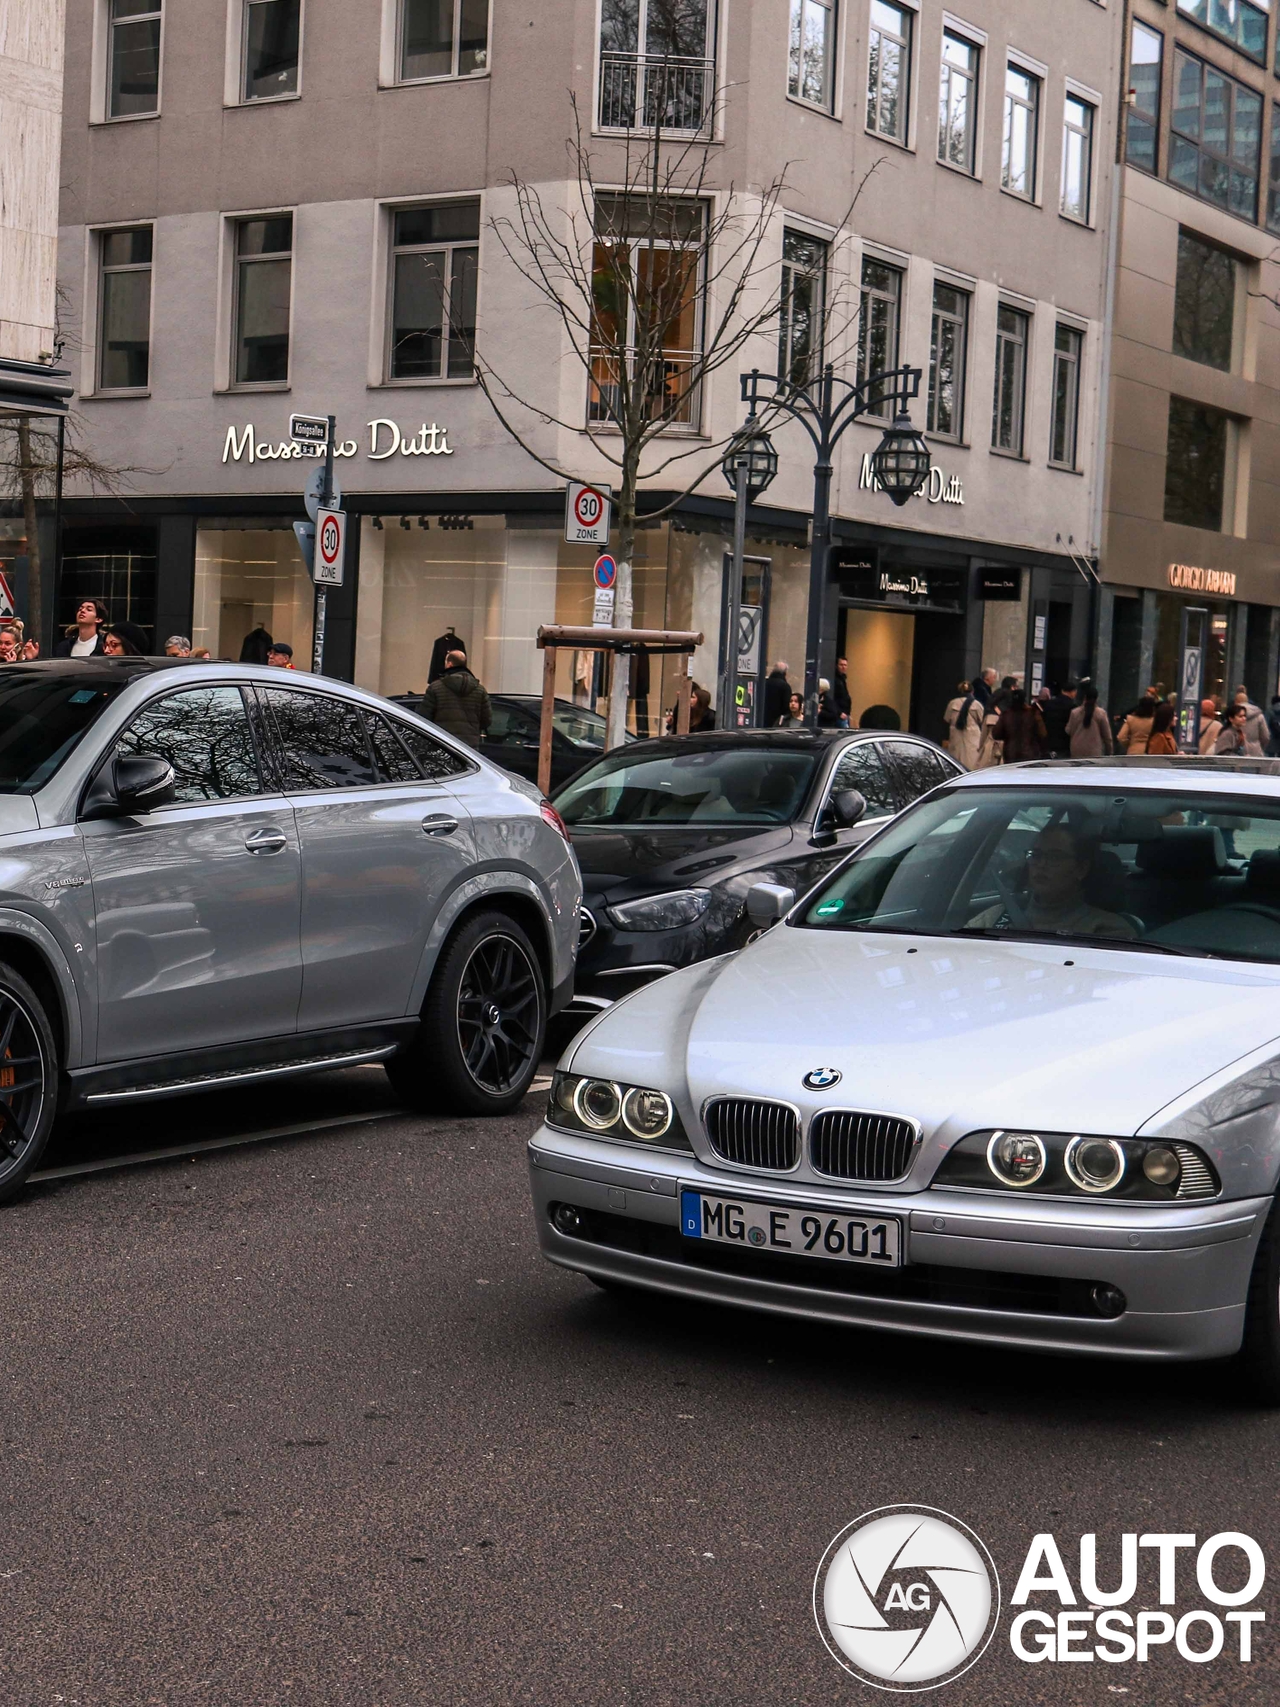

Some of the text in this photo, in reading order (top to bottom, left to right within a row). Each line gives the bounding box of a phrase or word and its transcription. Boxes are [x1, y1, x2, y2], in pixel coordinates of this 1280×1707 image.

[222, 418, 454, 464] Massmo Dutti
[928, 465, 965, 505] Dutti
[580, 498, 597, 516] 30
[324, 528, 337, 551] 30
[576, 528, 598, 540] ZONE
[321, 566, 336, 579] ZONE
[880, 573, 909, 592] Massimo
[910, 576, 928, 594] Dutti
[1170, 563, 1236, 596] GIORGIO ARMANI
[738, 658, 751, 670] ONE
[688, 1199, 892, 1261] D MG E 9601
